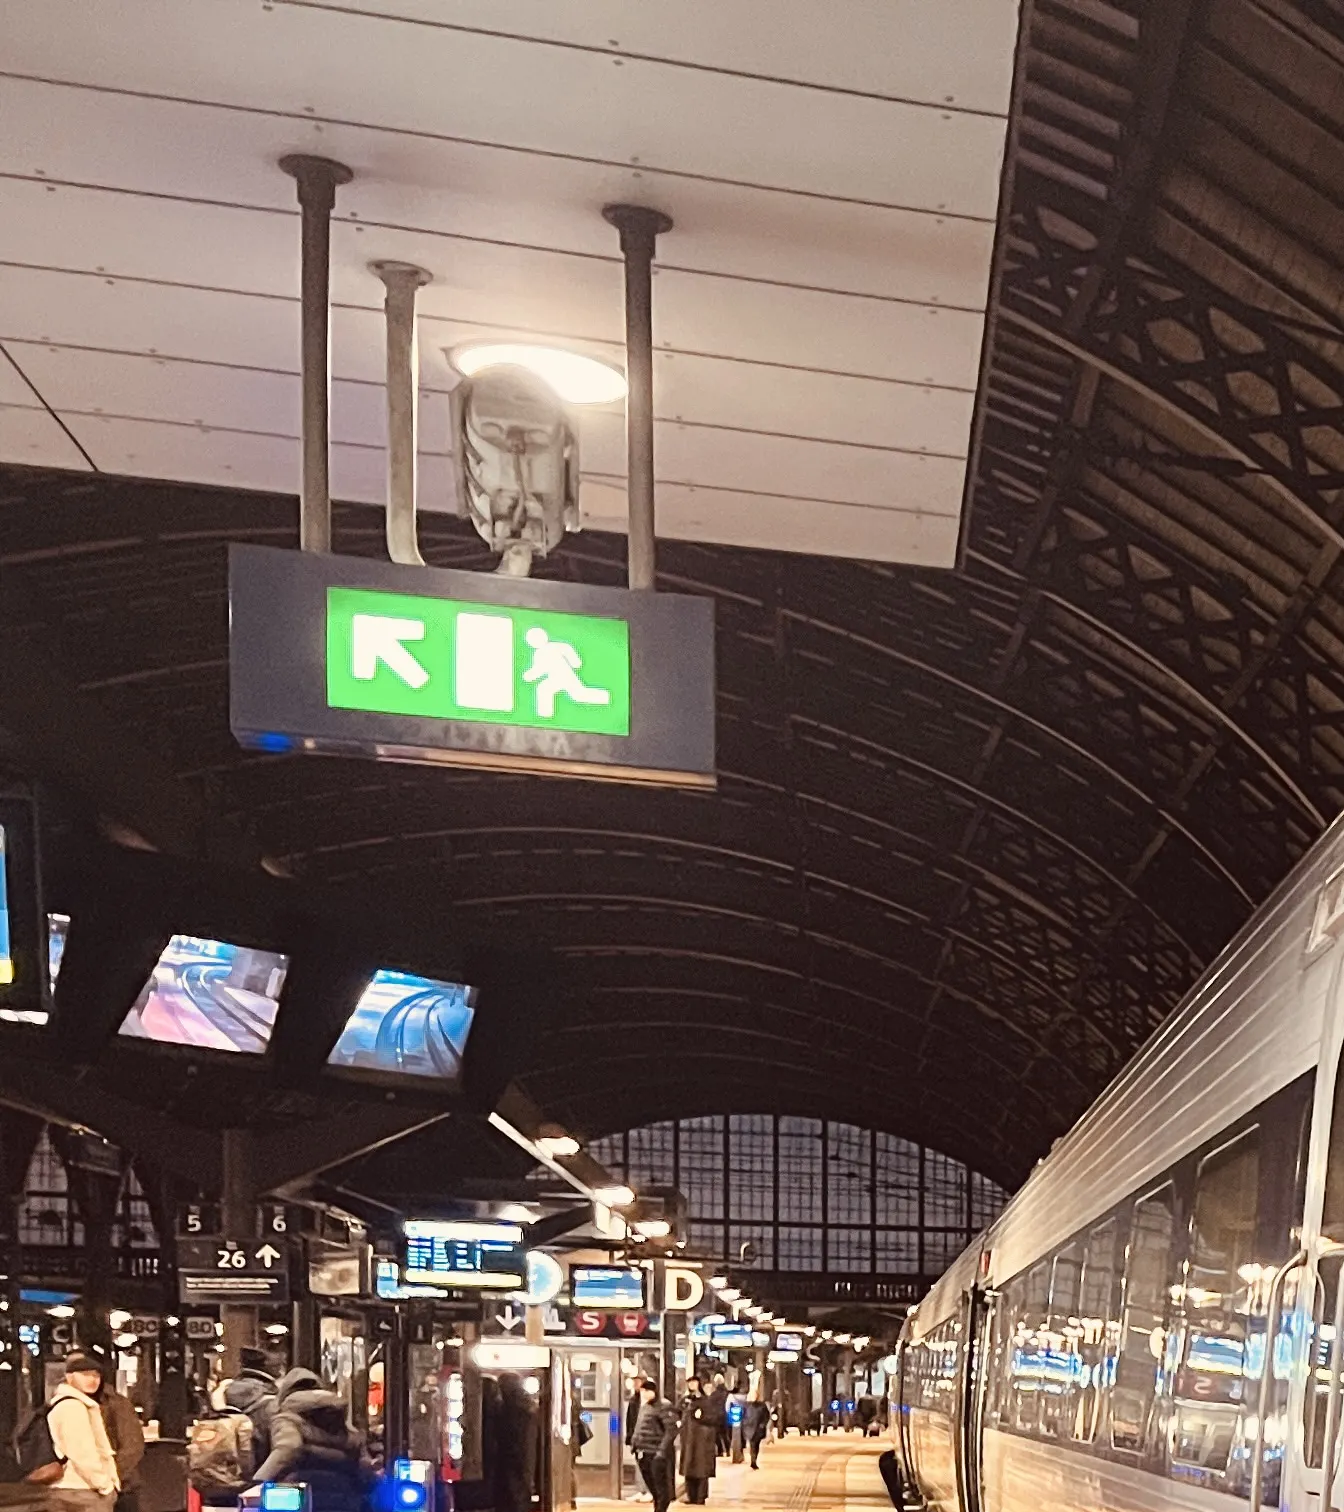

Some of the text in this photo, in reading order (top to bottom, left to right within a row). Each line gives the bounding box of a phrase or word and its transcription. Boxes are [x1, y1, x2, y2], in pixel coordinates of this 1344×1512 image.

[187, 1214, 202, 1232] 5
[272, 1214, 287, 1232] 6
[217, 1250, 247, 1269] 26
[664, 1268, 704, 1310] D
[582, 1312, 600, 1330] S
